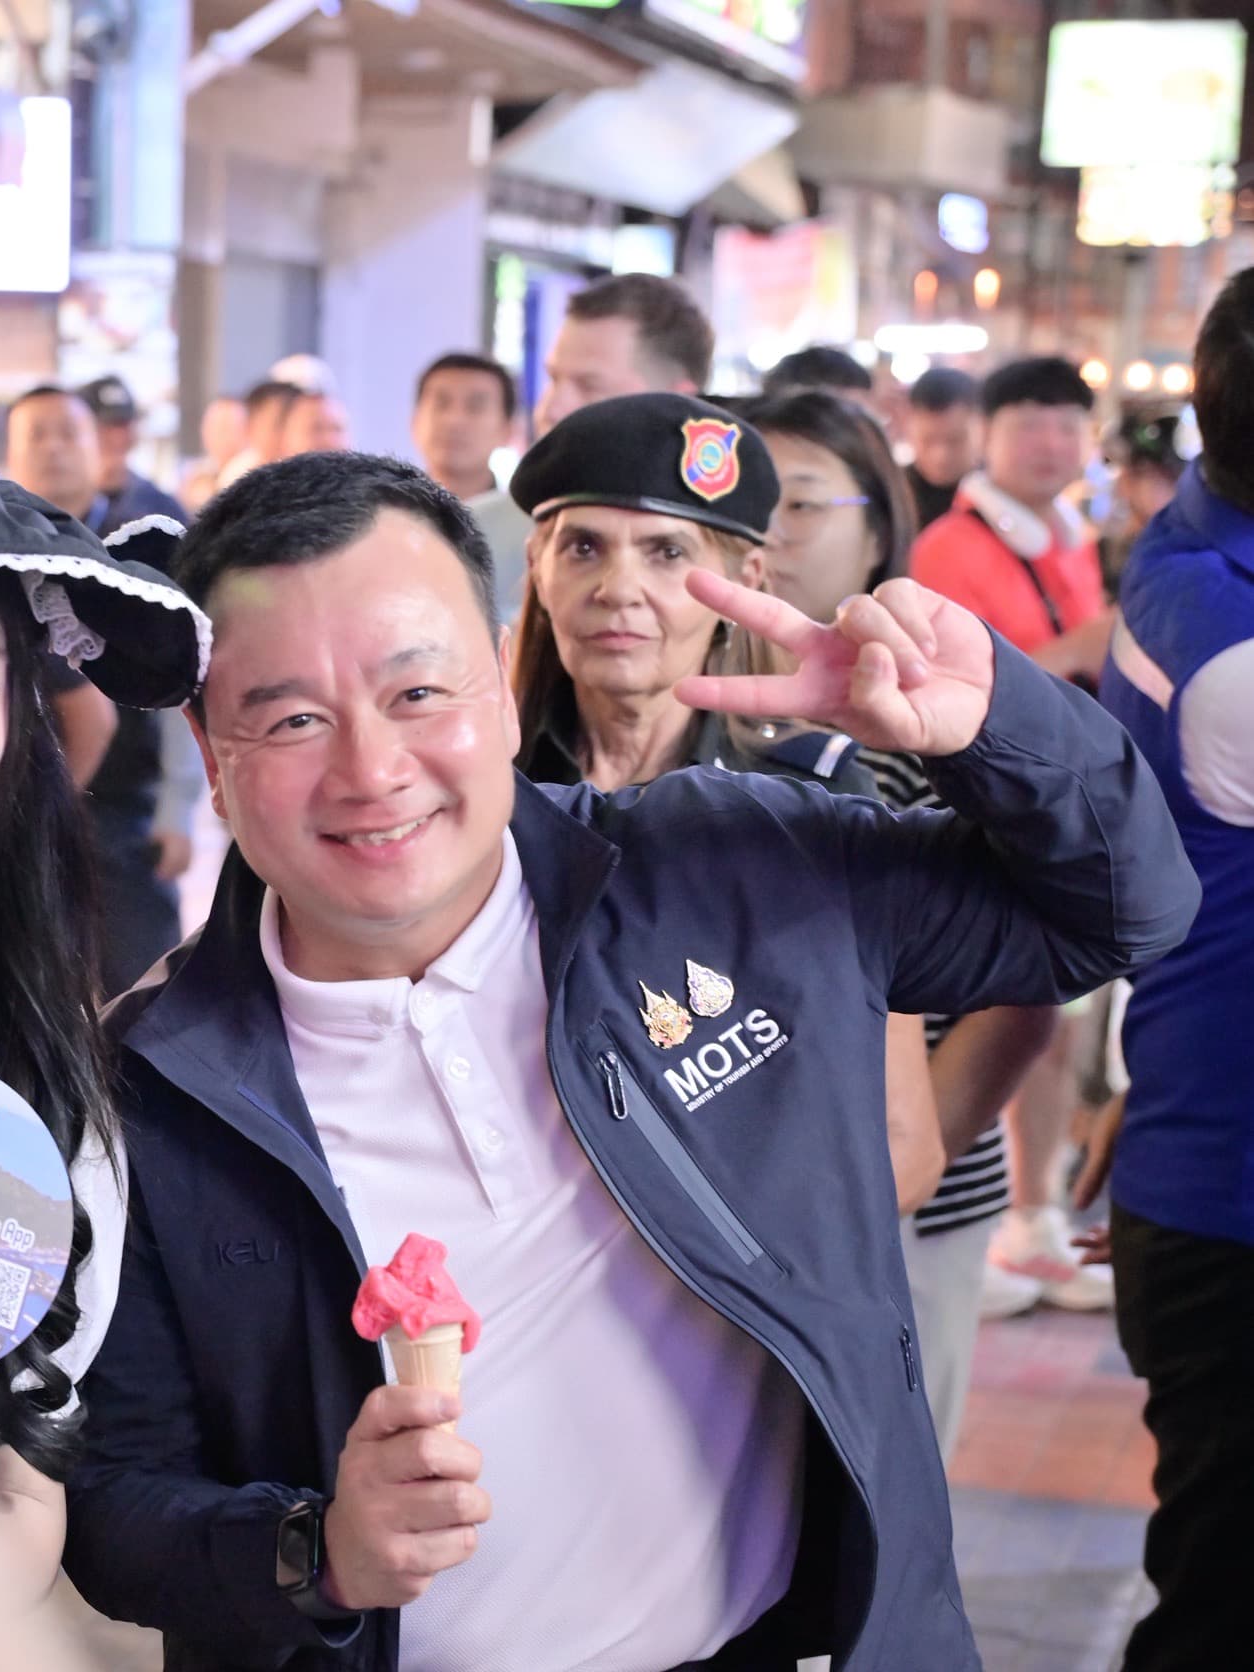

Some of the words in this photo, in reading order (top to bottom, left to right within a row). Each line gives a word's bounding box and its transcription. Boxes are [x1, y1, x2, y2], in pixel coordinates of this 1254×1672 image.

[662, 1008, 780, 1104] MOTS
[685, 1087, 716, 1112] MINISTRY
[715, 1081, 726, 1093] OF
[723, 1062, 750, 1087] TOURISM
[750, 1054, 765, 1069] AND
[763, 1034, 789, 1060] SPORTS
[2, 1219, 35, 1252] App
